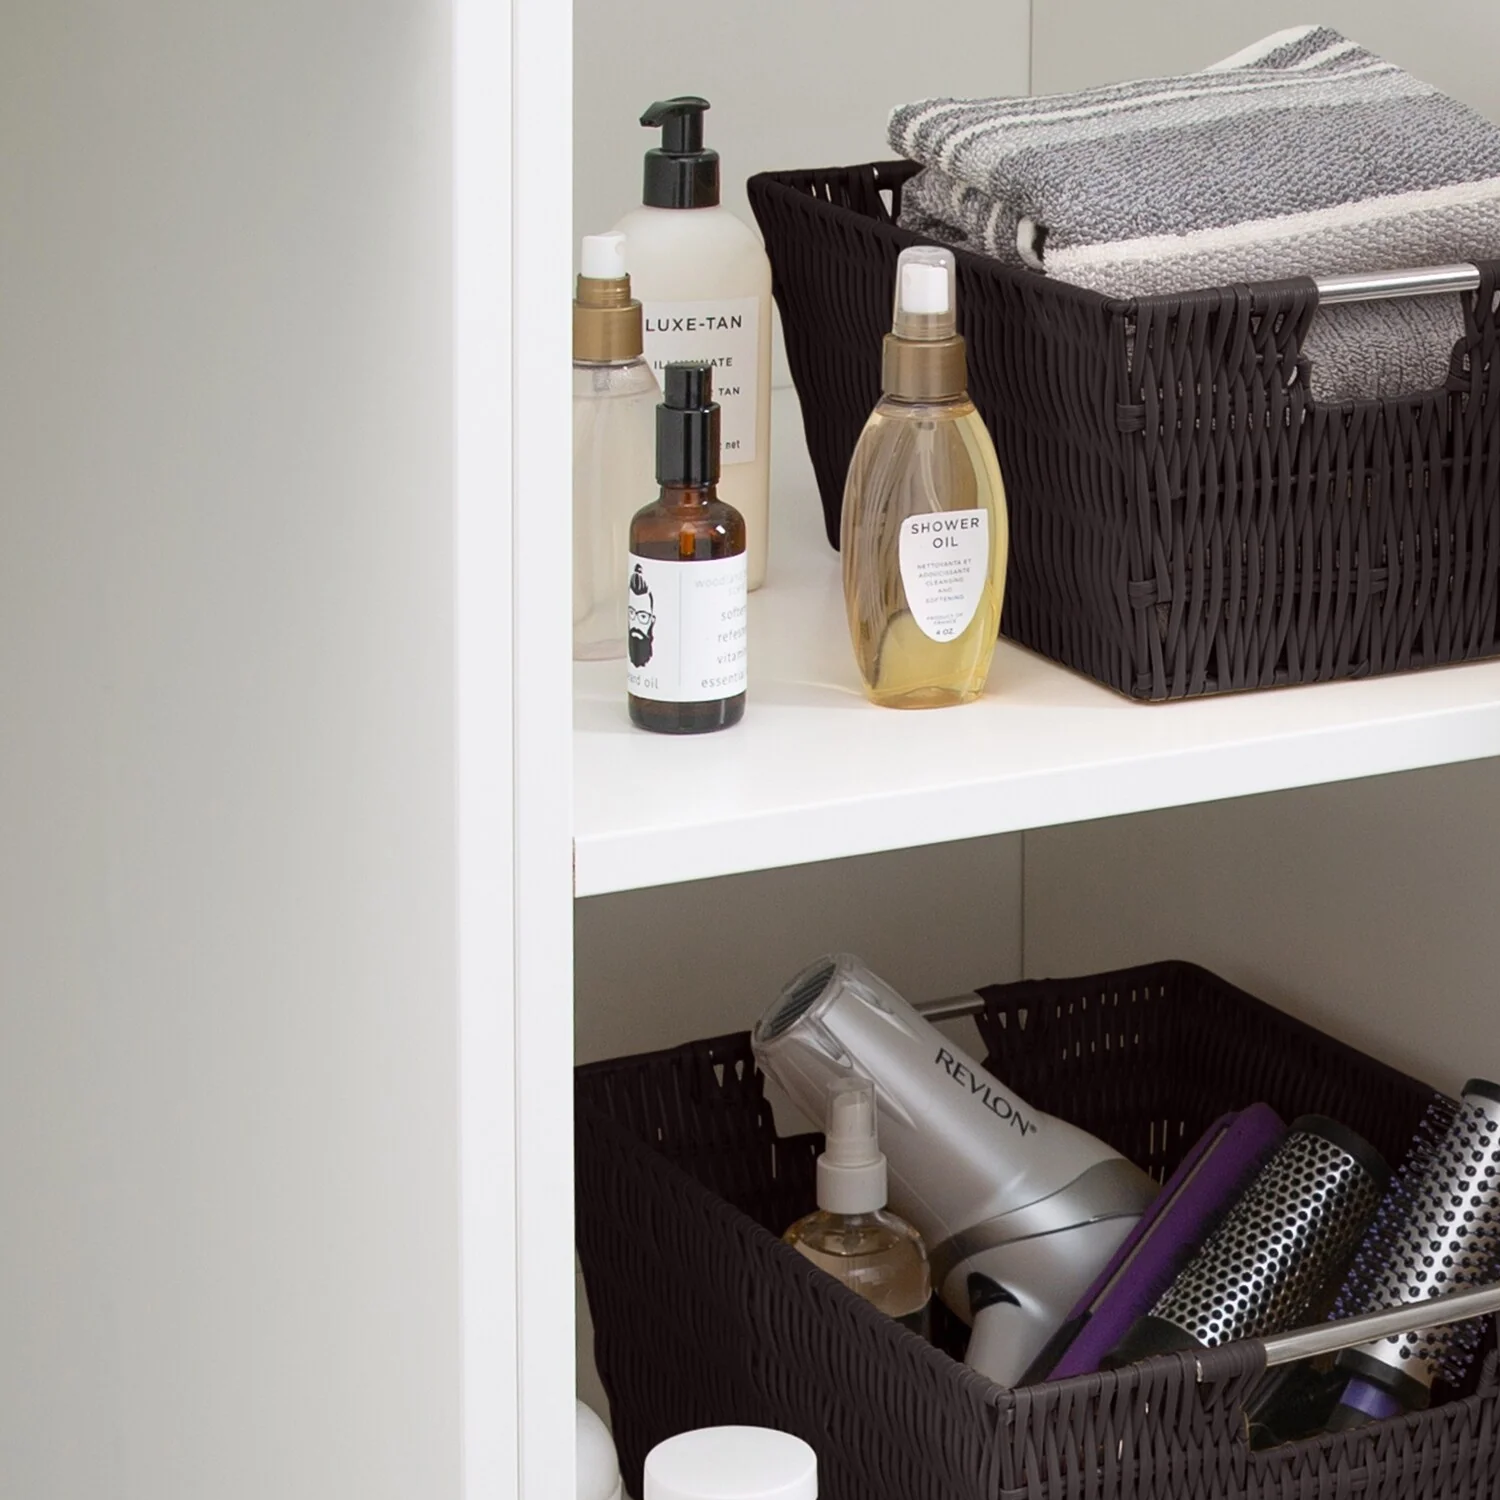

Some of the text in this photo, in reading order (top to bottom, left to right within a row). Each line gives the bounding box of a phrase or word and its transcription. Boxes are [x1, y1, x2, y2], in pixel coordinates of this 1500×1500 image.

[645, 315, 742, 332] LUXE-TAN
[719, 387, 740, 396] TAN
[911, 517, 980, 535] SHOWER
[932, 536, 958, 549] OIL
[644, 677, 658, 688] oil
[935, 1047, 1030, 1136] REVLON
